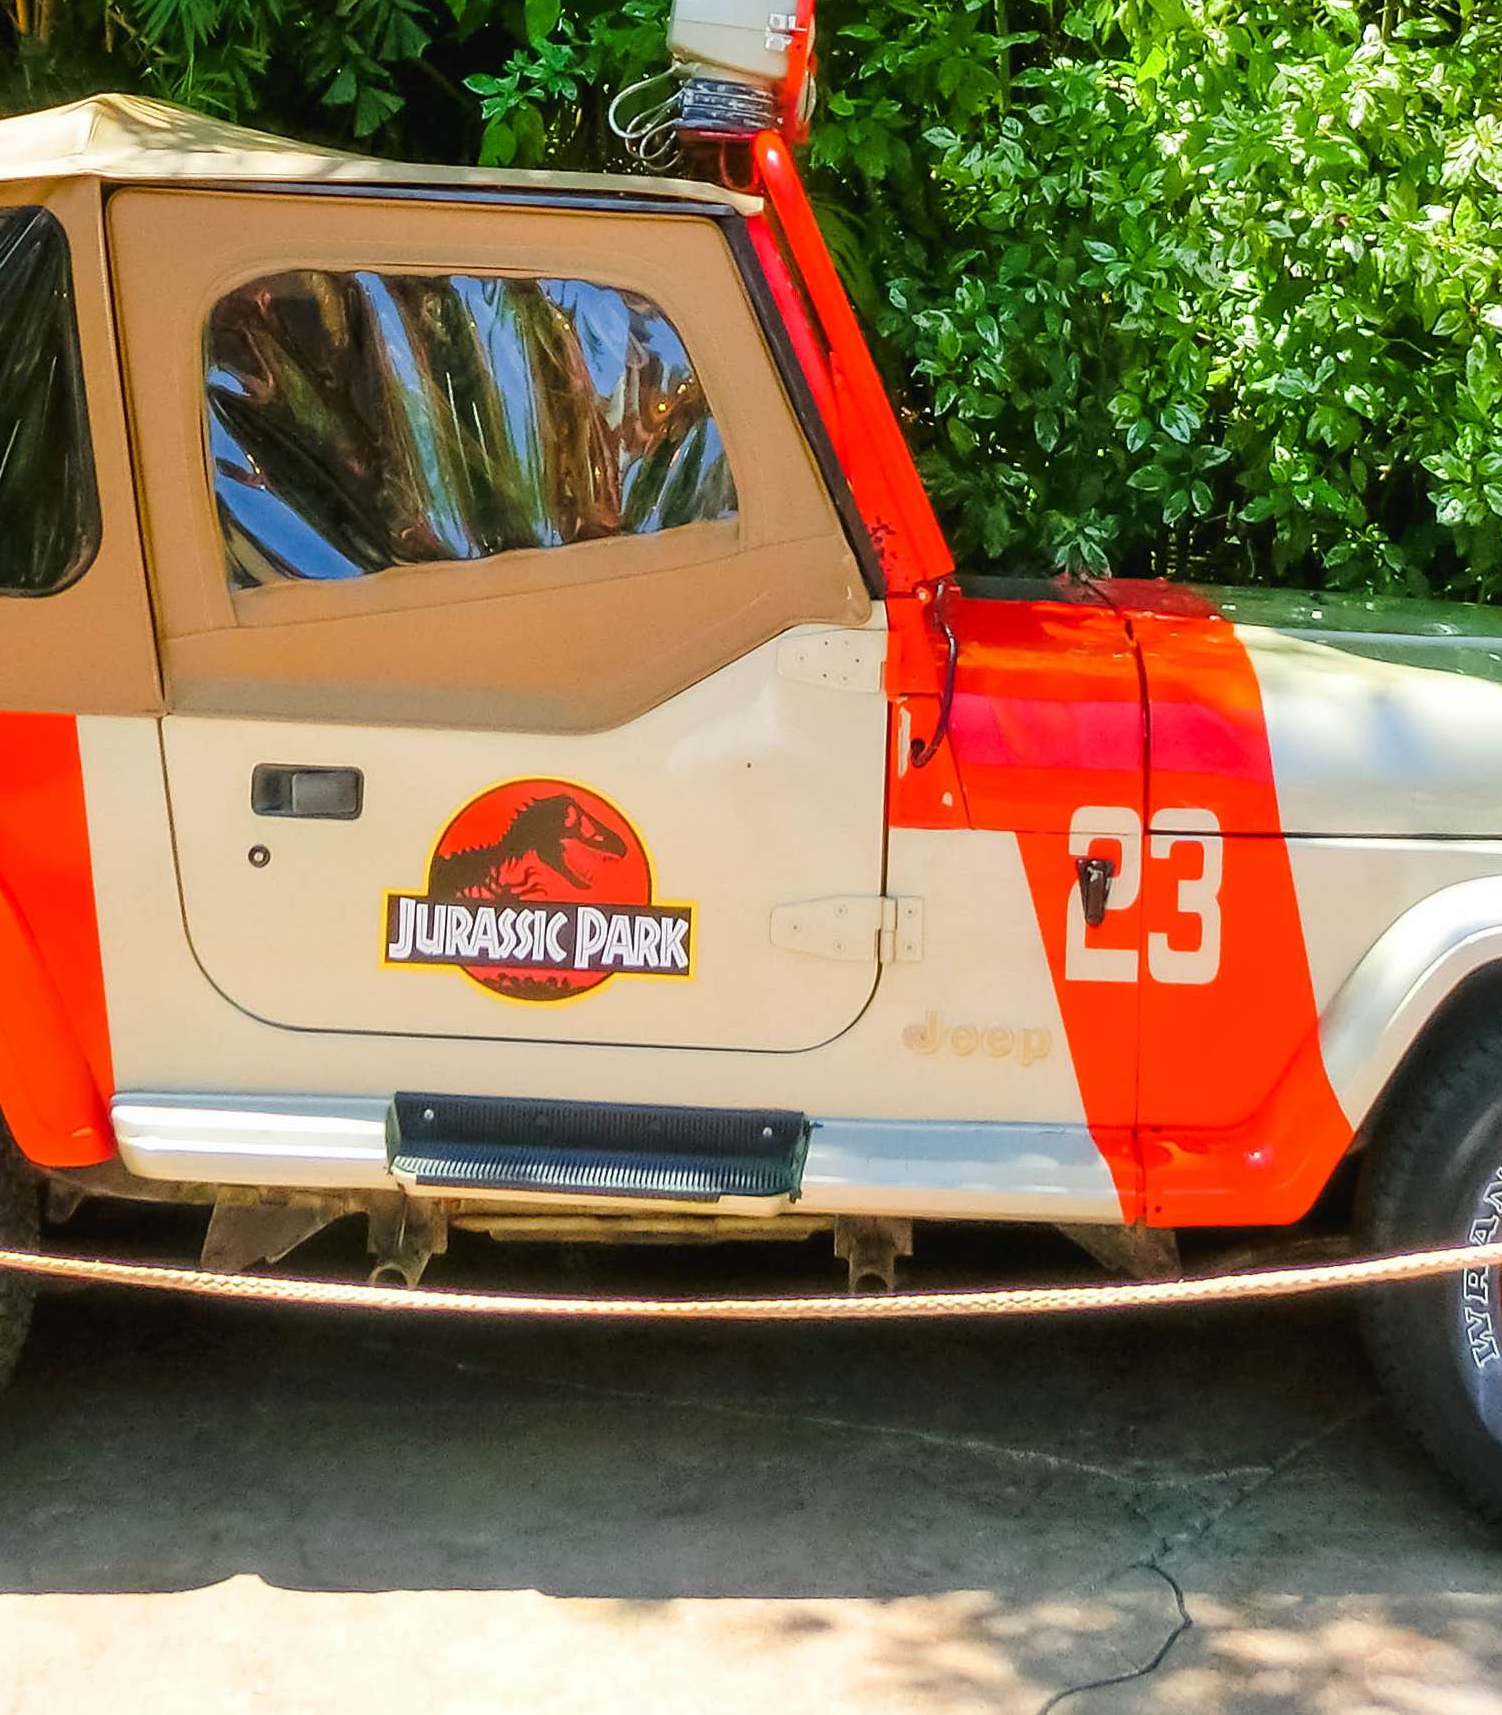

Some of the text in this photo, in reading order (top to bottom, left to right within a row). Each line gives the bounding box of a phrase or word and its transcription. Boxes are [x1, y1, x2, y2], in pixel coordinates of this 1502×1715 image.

[1065, 805, 1224, 985] 23
[388, 897, 690, 970] JURASSIC PARK
[902, 1010, 1052, 1067] Jeep
